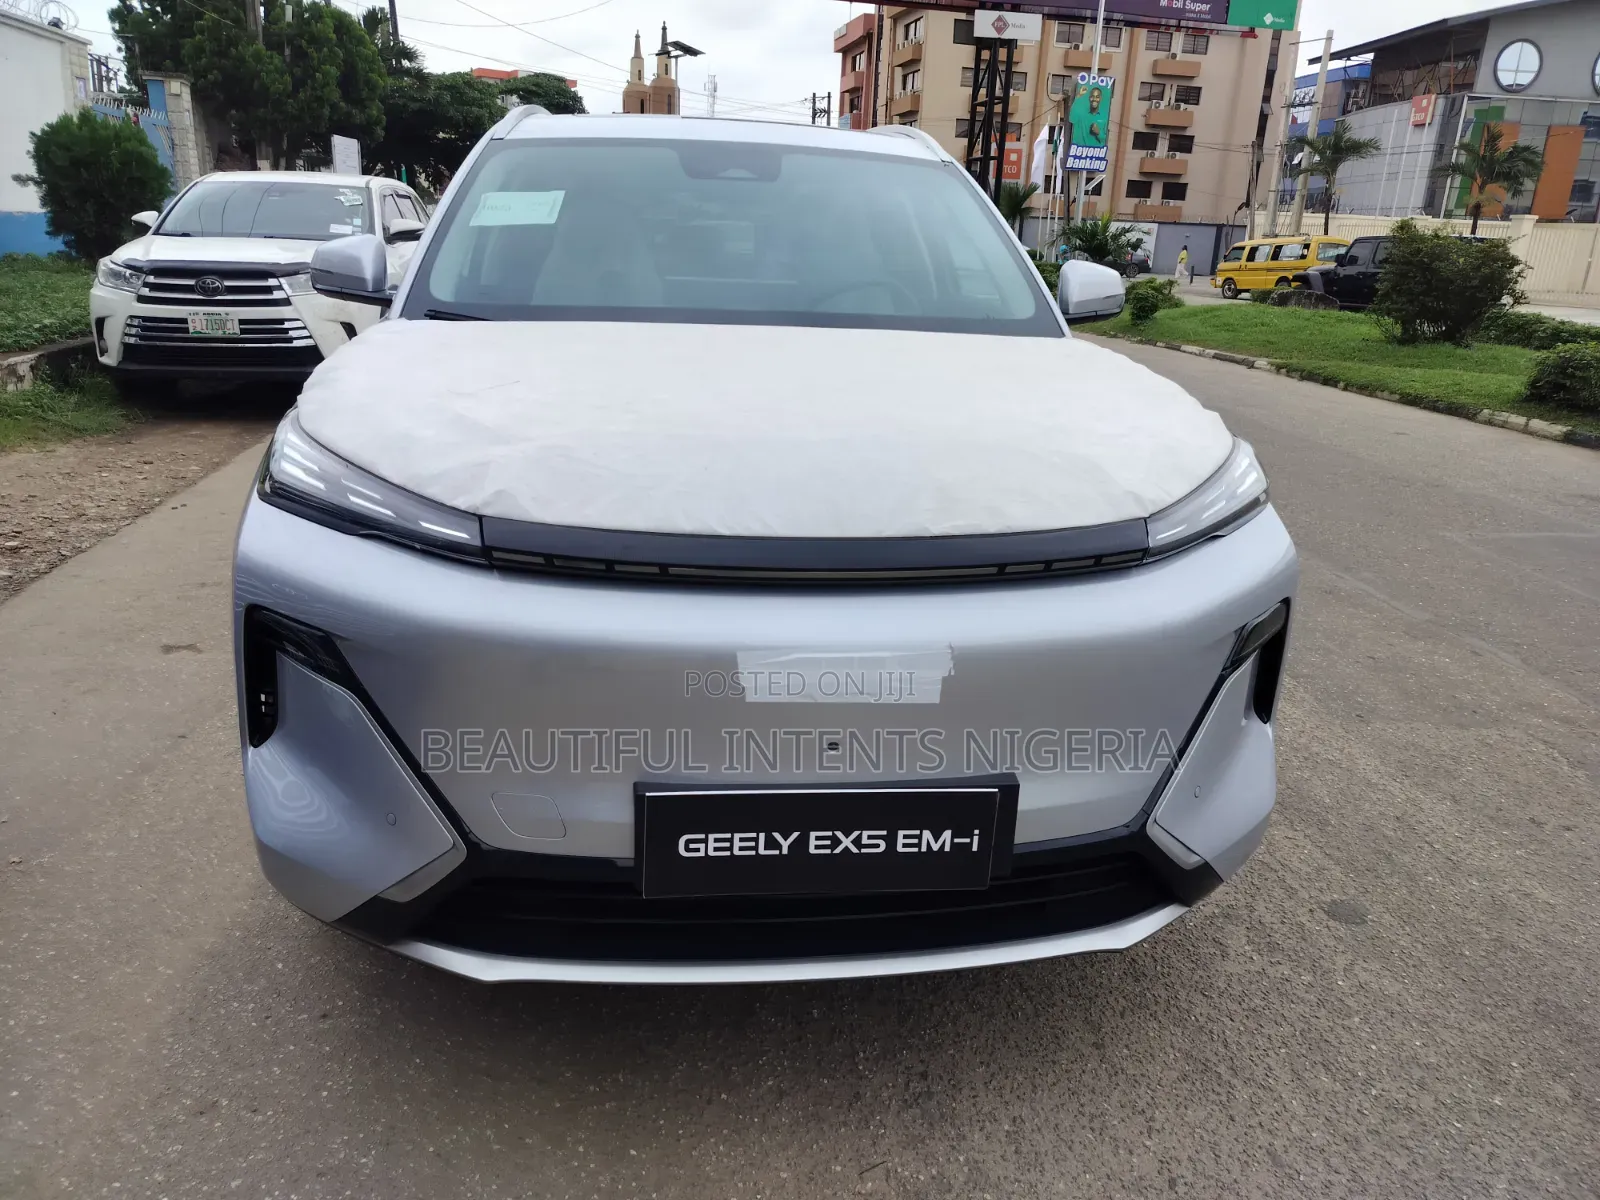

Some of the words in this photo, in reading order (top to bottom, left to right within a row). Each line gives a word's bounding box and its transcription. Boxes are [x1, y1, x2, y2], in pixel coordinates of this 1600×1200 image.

[1160, 0, 1183, 8] Mobil
[1185, 0, 1211, 11] Super
[1069, 144, 1107, 158] Beyond
[1066, 156, 1107, 171] Banking
[678, 831, 801, 857] GEELY
[808, 830, 887, 854] EX5
[896, 828, 980, 852] EM-i
